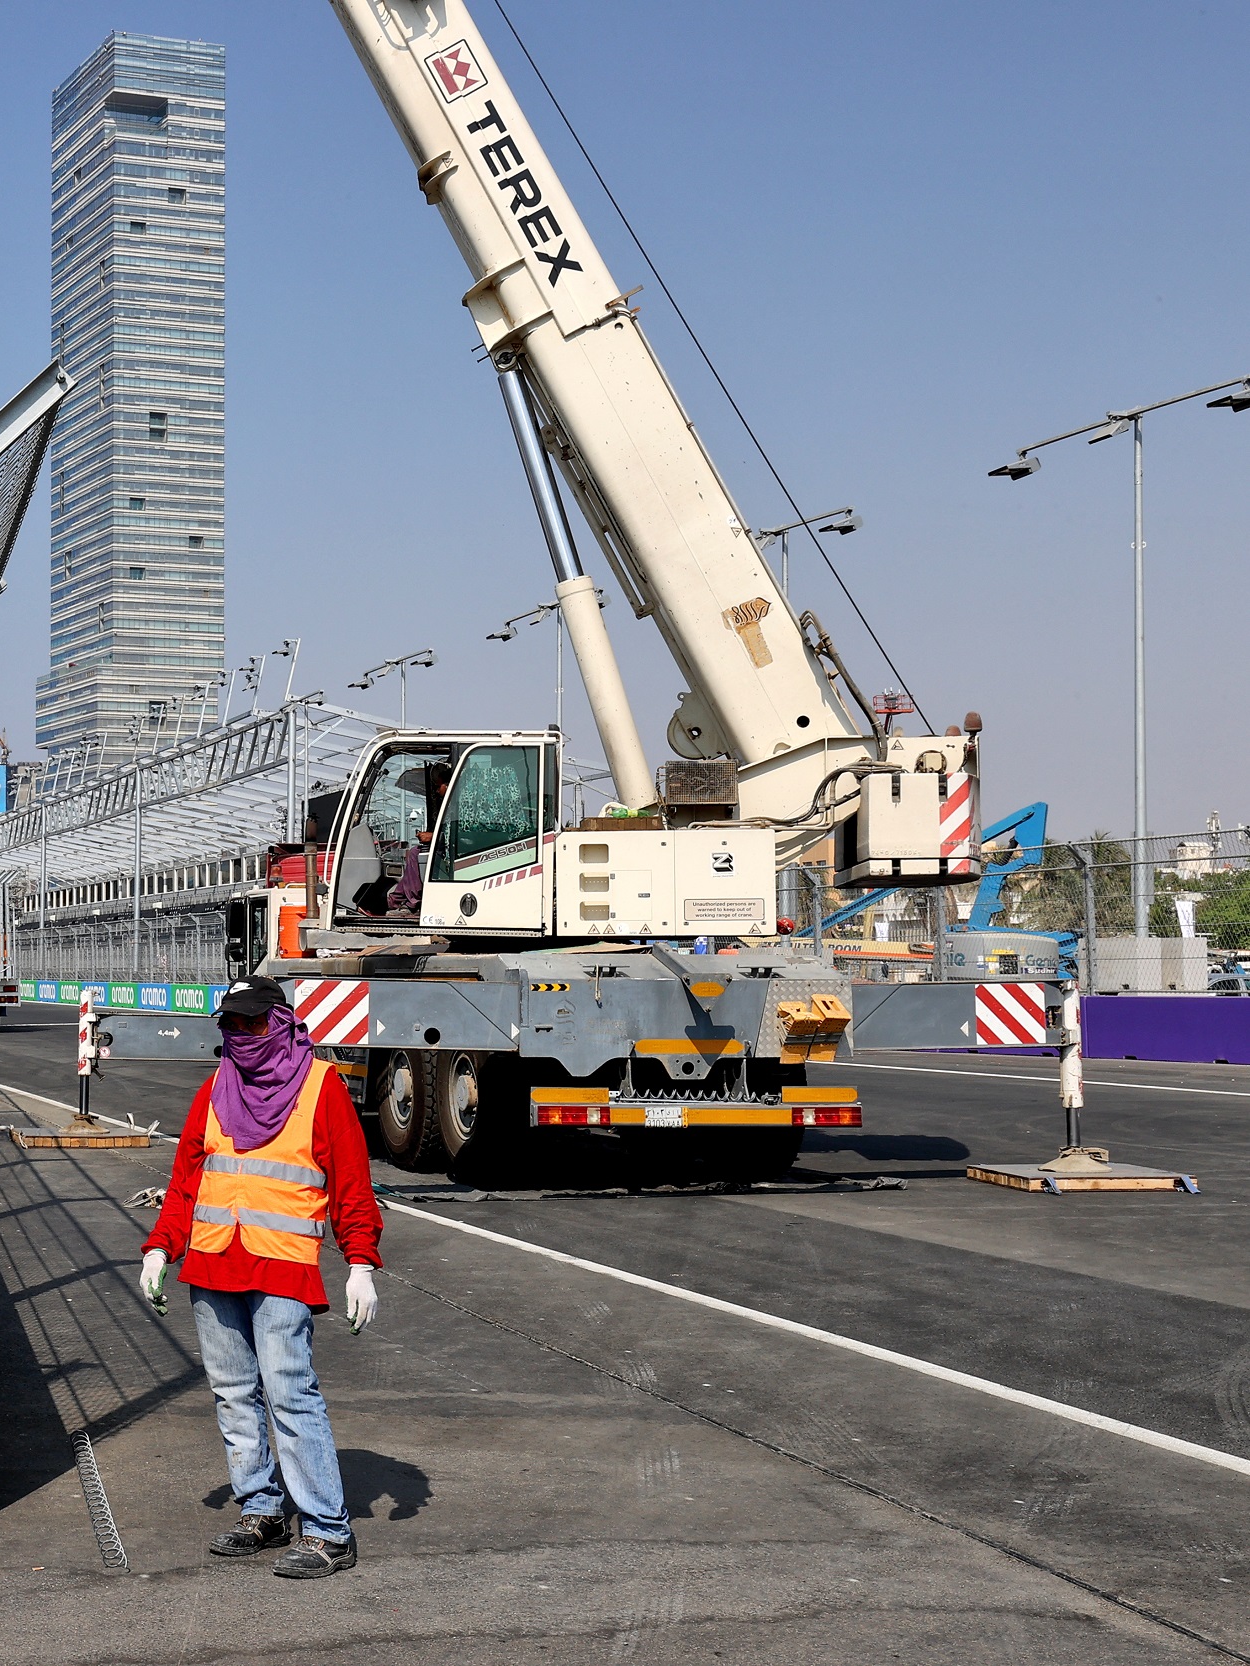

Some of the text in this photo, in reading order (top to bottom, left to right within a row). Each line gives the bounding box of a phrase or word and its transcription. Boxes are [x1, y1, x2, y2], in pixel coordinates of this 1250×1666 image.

[466, 99, 584, 288] TEREX
[38, 983, 56, 1000] aramco
[60, 984, 79, 1001] aramco
[111, 986, 135, 1005] aramco
[141, 987, 167, 1007] aramco
[175, 988, 204, 1010] aramco
